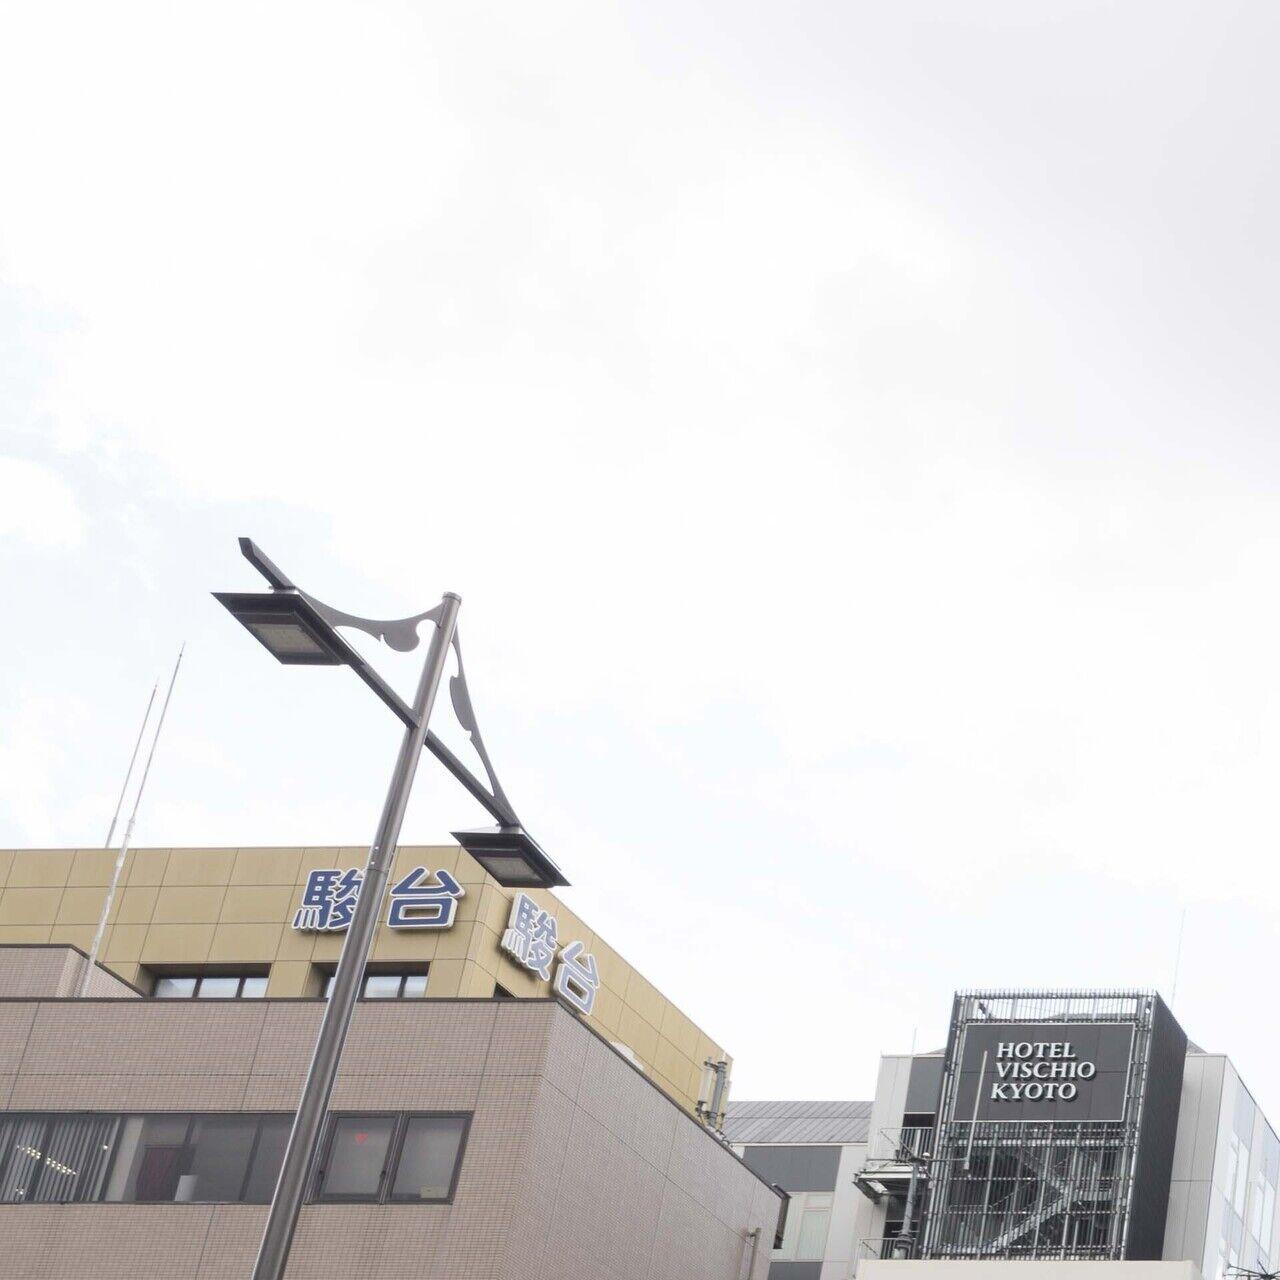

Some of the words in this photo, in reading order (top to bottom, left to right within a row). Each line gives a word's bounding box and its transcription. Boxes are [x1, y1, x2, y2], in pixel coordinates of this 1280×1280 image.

[292, 867, 465, 931] 駿台
[501, 892, 601, 1016] 駿台
[996, 1042, 1076, 1060] HOTEL
[996, 1062, 1096, 1080] VISCHIO
[990, 1083, 1077, 1100] KYOTO
